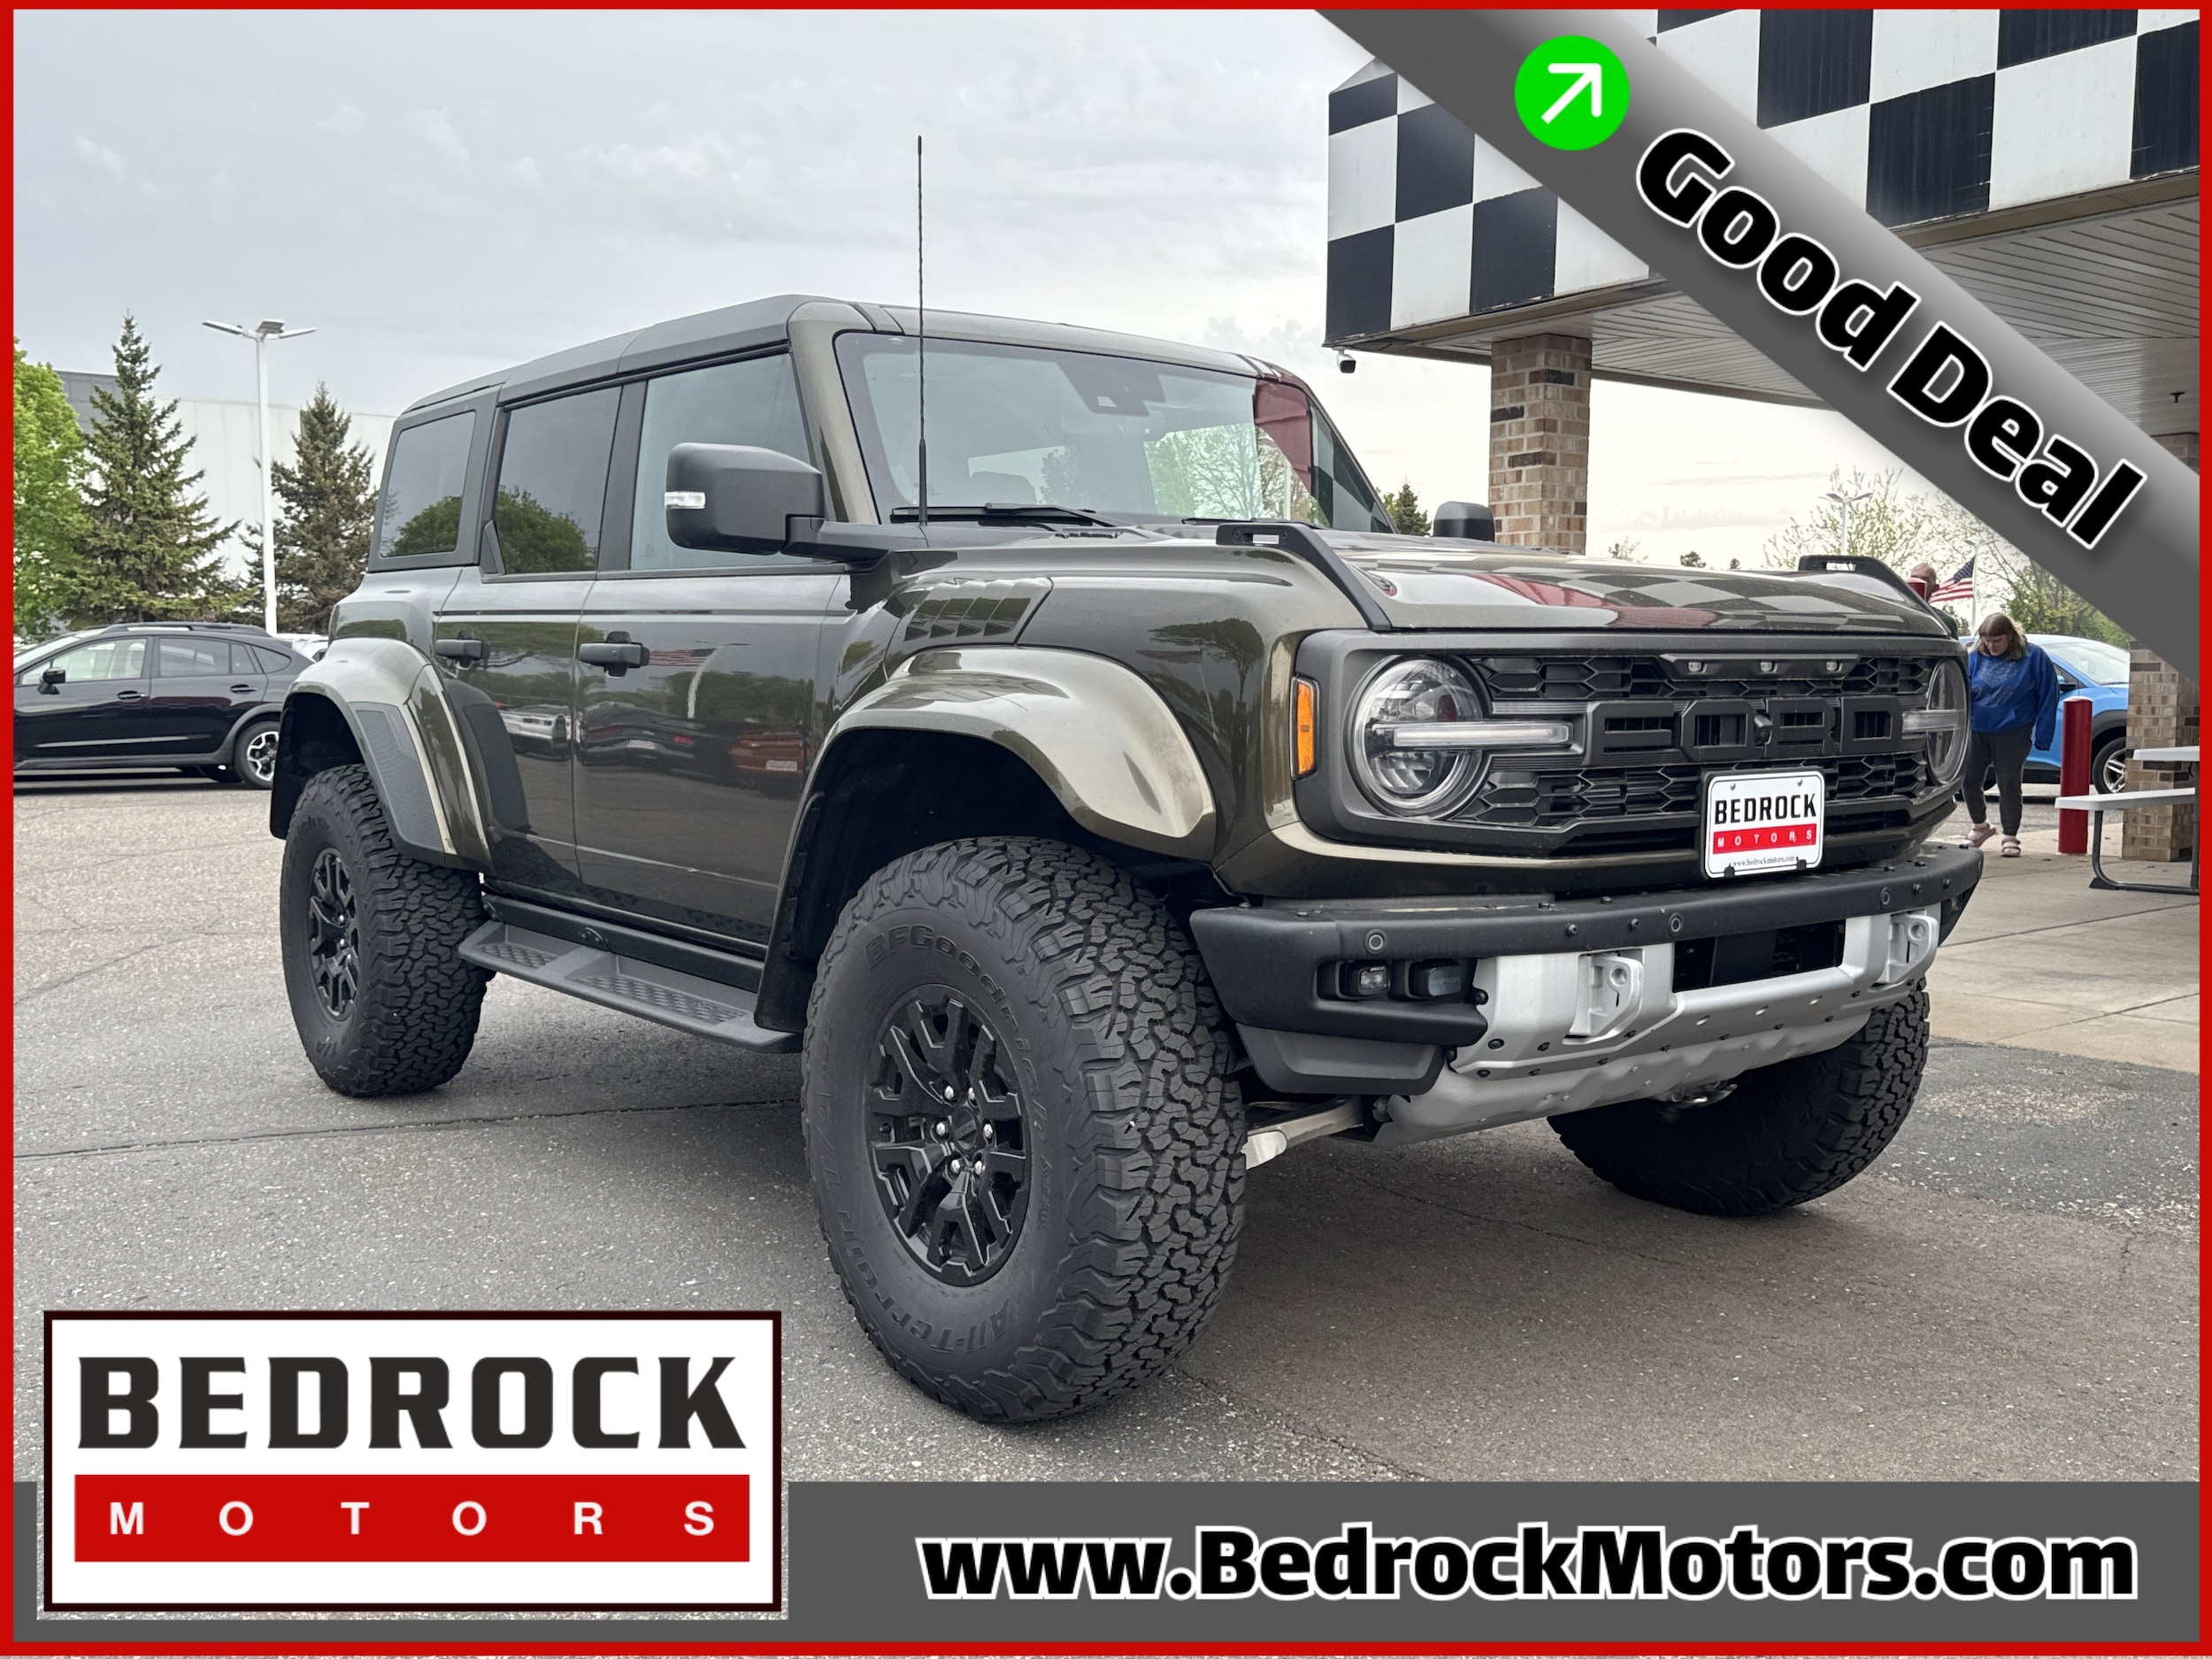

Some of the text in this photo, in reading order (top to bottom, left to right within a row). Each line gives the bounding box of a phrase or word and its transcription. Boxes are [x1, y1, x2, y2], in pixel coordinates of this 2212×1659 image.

[1586, 695, 1903, 765] FORD
[1714, 793, 1816, 825] BEDROCK
[1717, 829, 1813, 849] MOTORS
[1732, 856, 1795, 867] www.bedrockmotors.com
